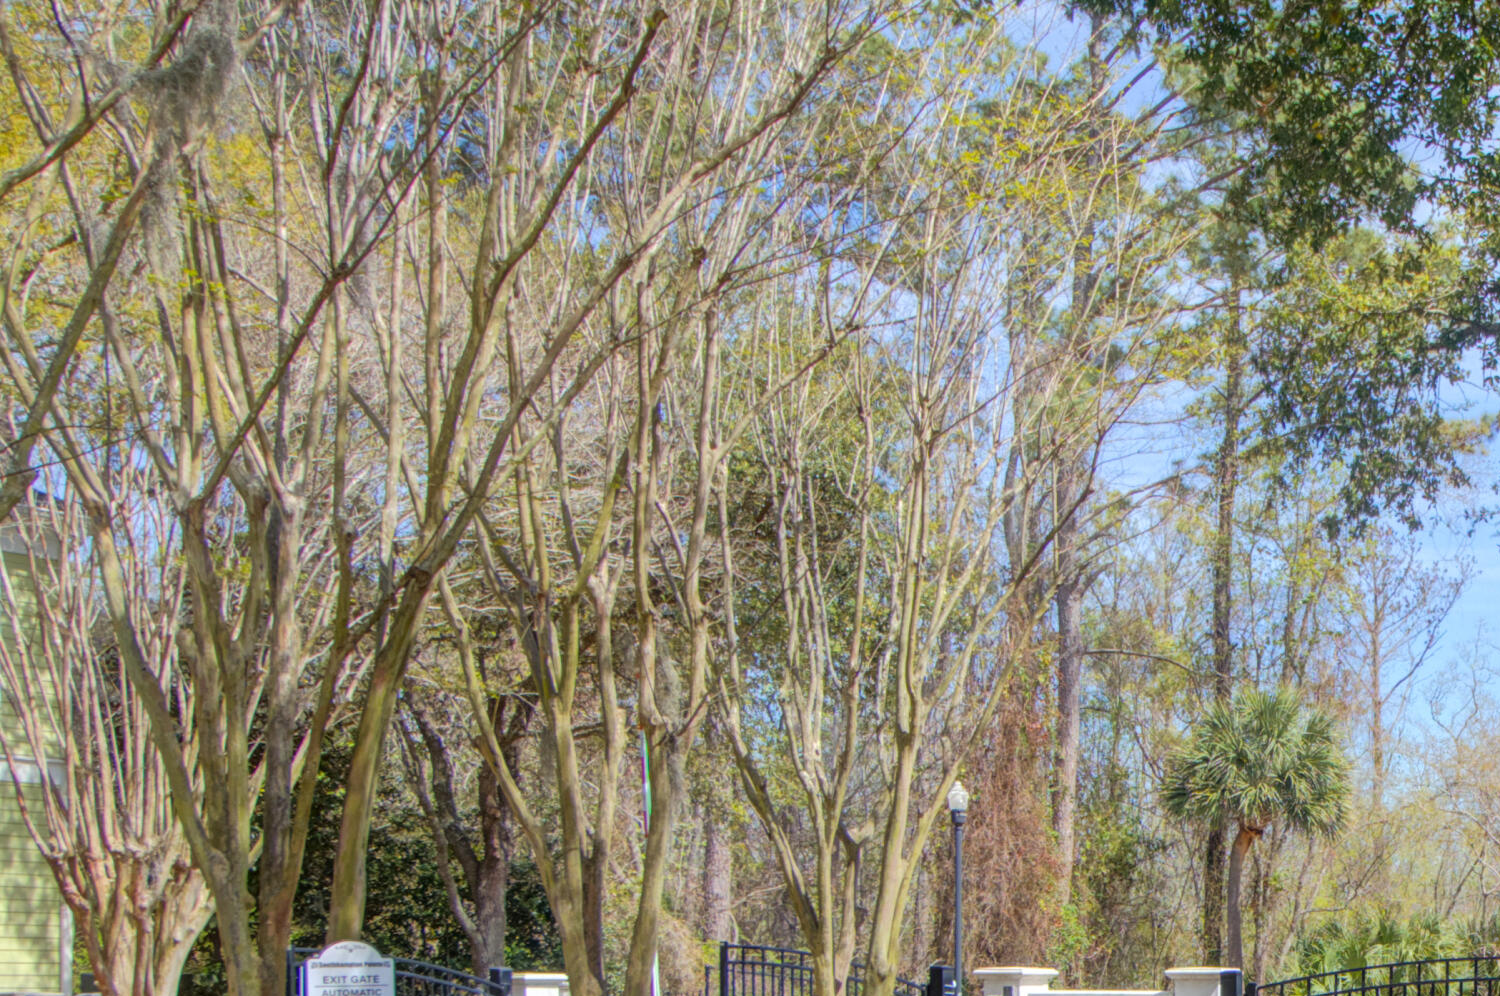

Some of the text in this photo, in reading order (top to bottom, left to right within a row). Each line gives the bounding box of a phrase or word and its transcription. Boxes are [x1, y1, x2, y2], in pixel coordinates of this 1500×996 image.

[322, 975, 380, 984] EXIT GATE
[321, 988, 382, 996] AUTOMATIC
